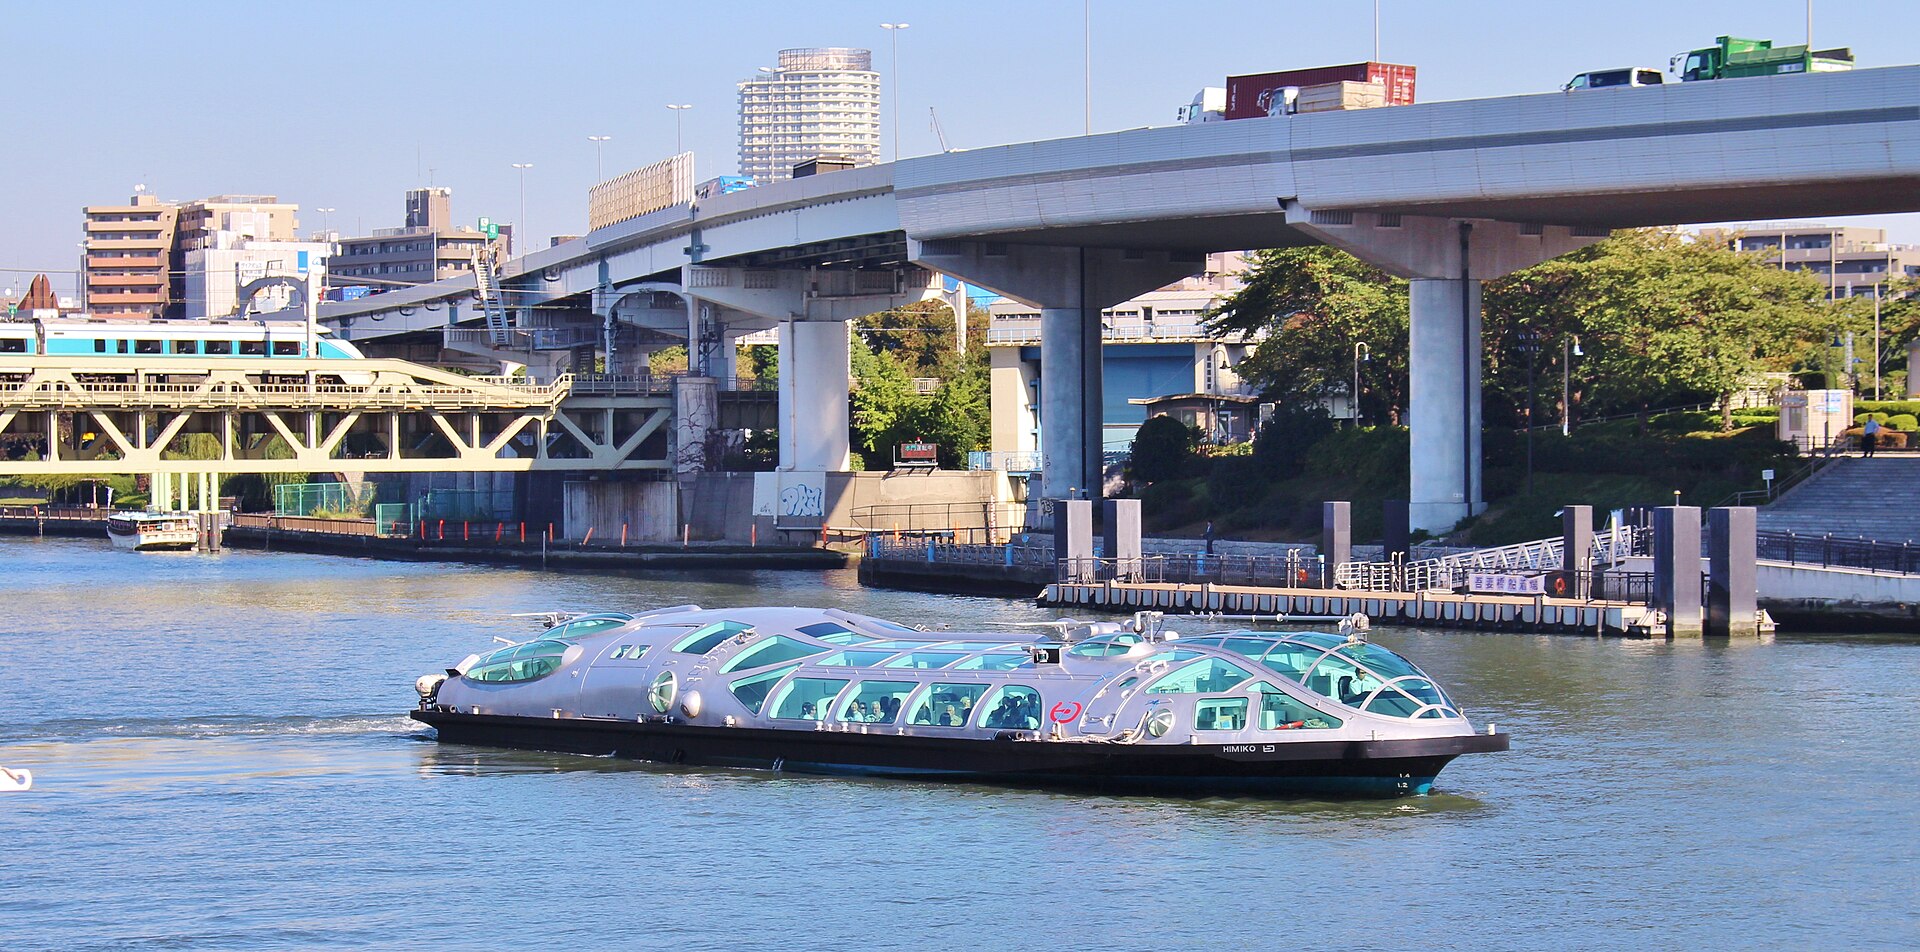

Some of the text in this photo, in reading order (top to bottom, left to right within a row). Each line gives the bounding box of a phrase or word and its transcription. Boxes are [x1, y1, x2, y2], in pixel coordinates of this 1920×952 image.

[1475, 577, 1538, 591] 吾妻橋船着場
[1223, 745, 1256, 753] HIMIKO
